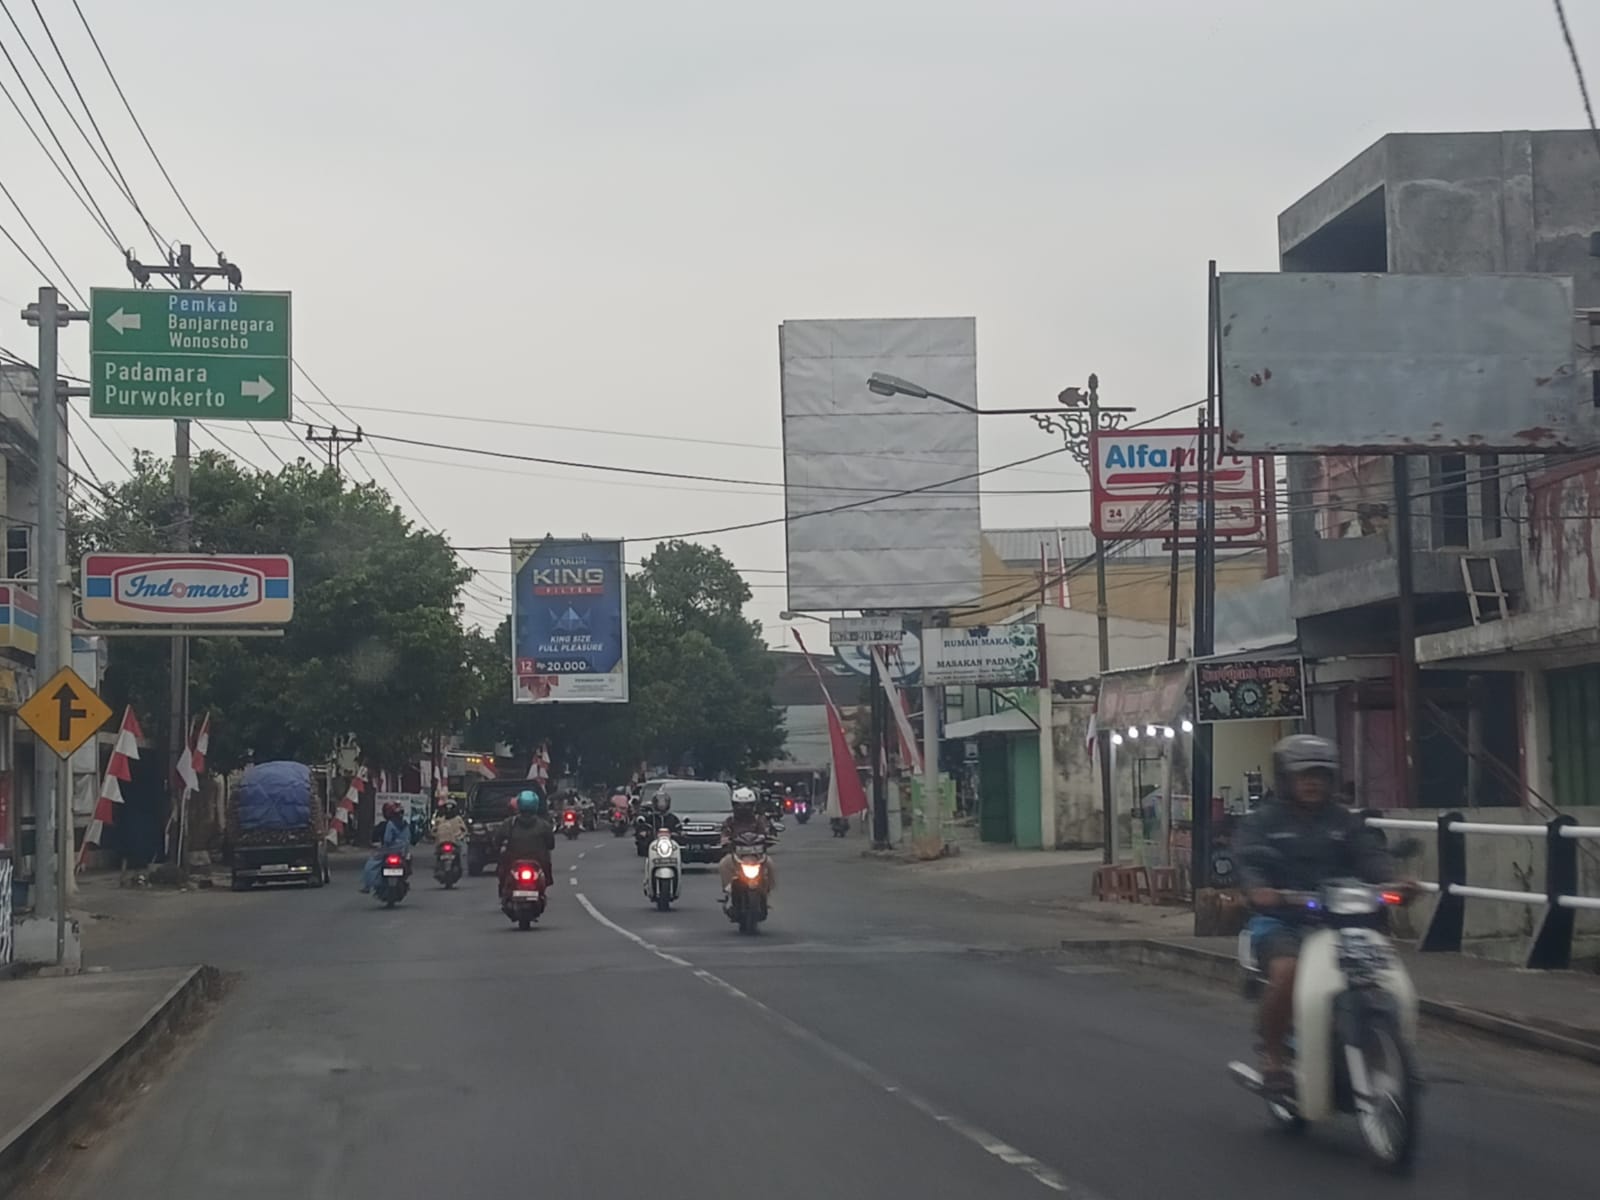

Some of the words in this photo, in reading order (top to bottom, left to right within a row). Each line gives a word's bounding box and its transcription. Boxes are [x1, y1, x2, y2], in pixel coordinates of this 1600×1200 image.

[168, 295, 238, 313] Pemkab
[168, 314, 275, 335] Banjarnegara
[169, 332, 248, 349] Wonosobo
[105, 362, 207, 383] Padamara
[105, 385, 225, 407] Purwokerto
[1105, 443, 1244, 469] Alfamr
[533, 568, 604, 585] KING
[124, 574, 249, 599] Indomaret
[551, 635, 571, 643] KING
[944, 639, 978, 649] RUMAH
[538, 645, 558, 653] FULL
[561, 643, 604, 652] PLEASURE
[521, 661, 533, 672] 12
[547, 661, 587, 672] 20.000
[937, 659, 982, 668] MASAKAN
